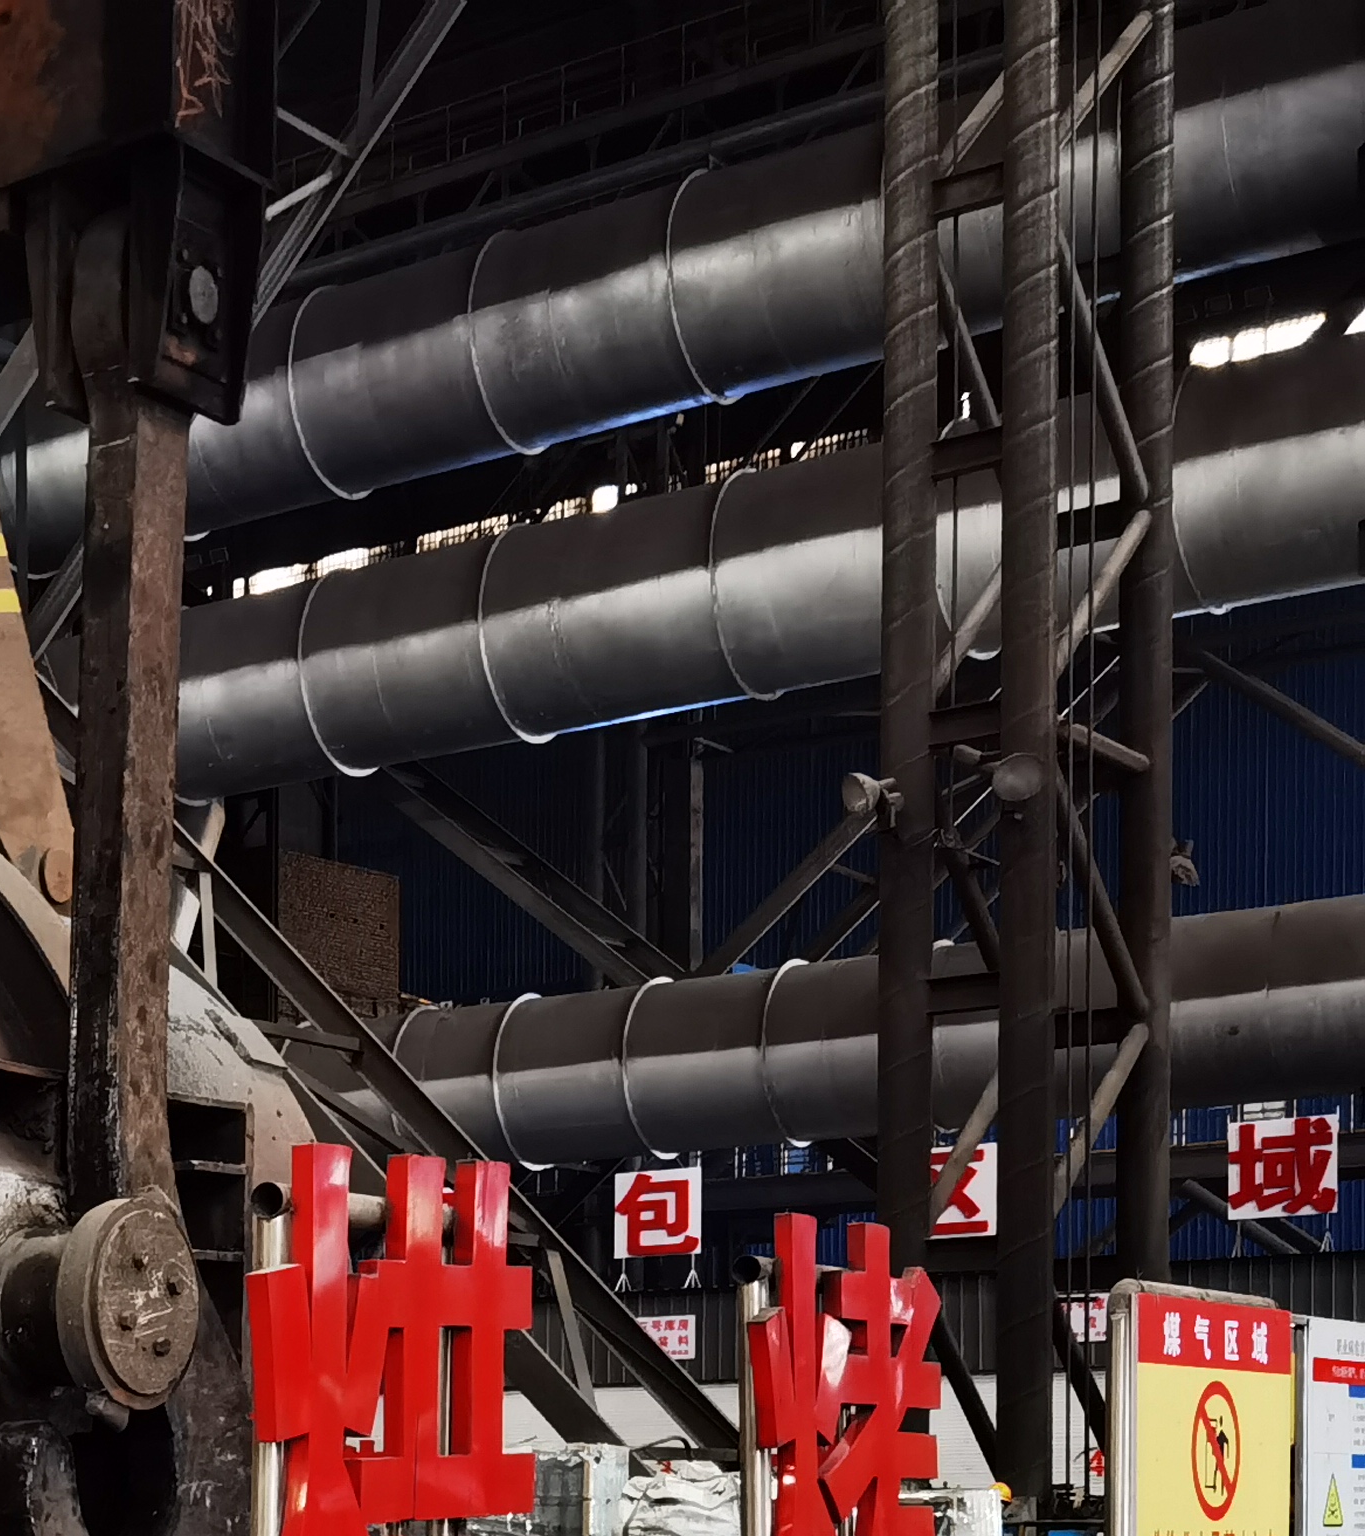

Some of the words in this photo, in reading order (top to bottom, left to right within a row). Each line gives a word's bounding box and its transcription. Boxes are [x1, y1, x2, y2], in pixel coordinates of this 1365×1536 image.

[615, 1173, 700, 1257] 包
[1227, 1116, 1337, 1215] 域
[1163, 1311, 1269, 1365] 煤气区域
